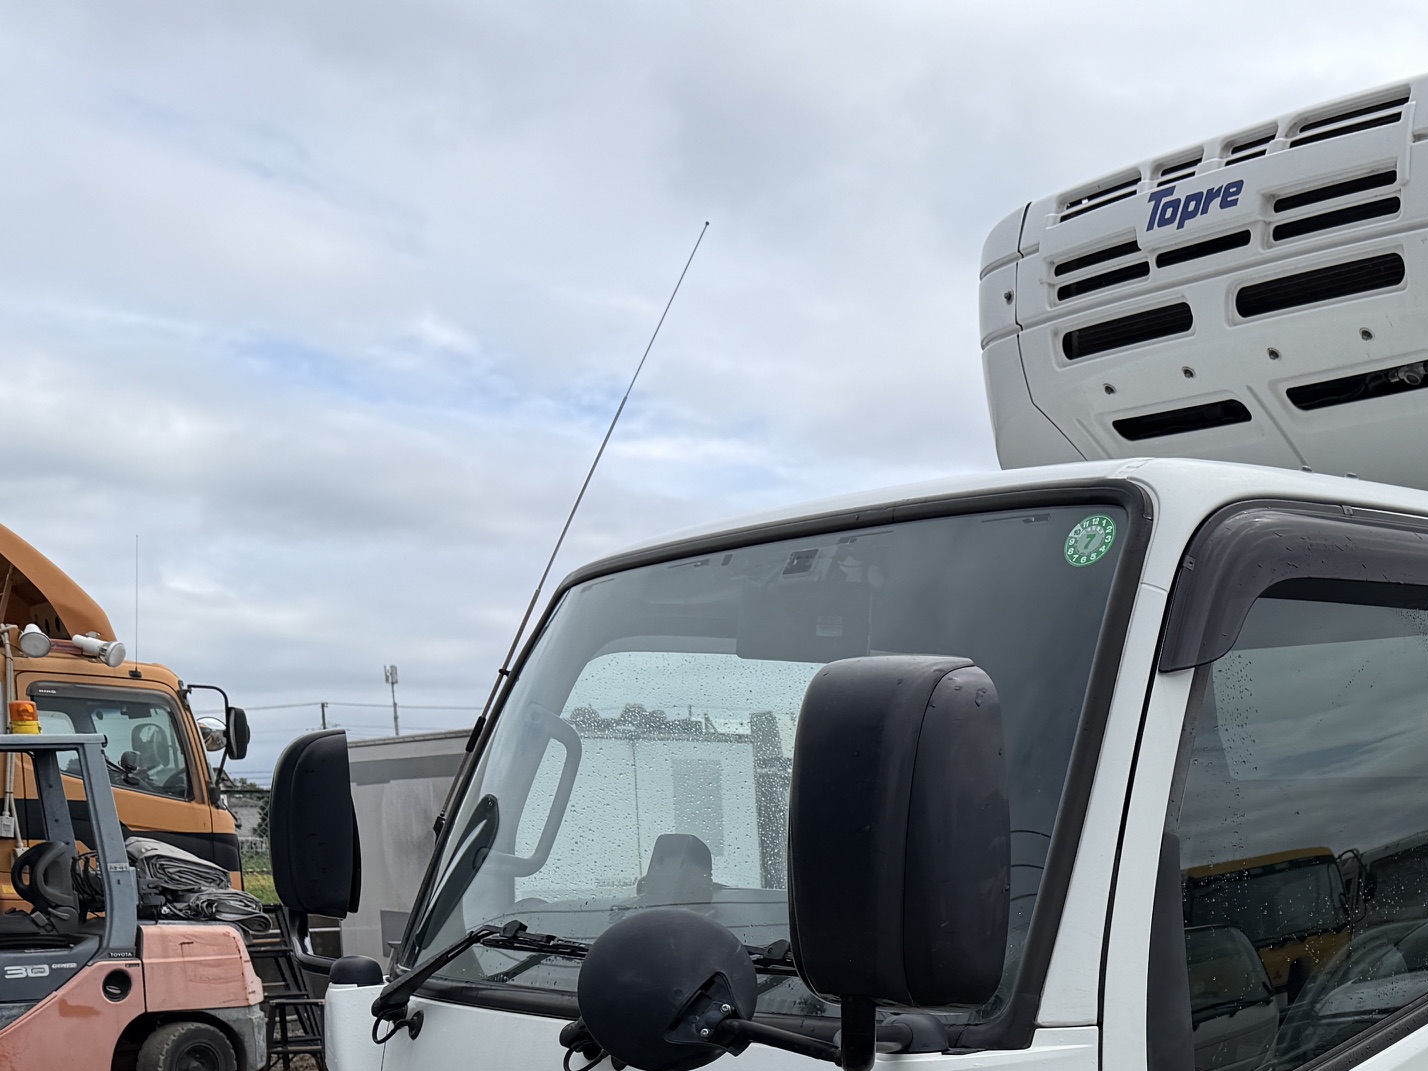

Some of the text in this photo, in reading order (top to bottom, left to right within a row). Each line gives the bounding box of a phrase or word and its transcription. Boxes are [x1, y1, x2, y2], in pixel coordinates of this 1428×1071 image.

[1146, 180, 1244, 232] Topre
[1084, 533, 1096, 550] 7
[4, 964, 50, 979] 30
